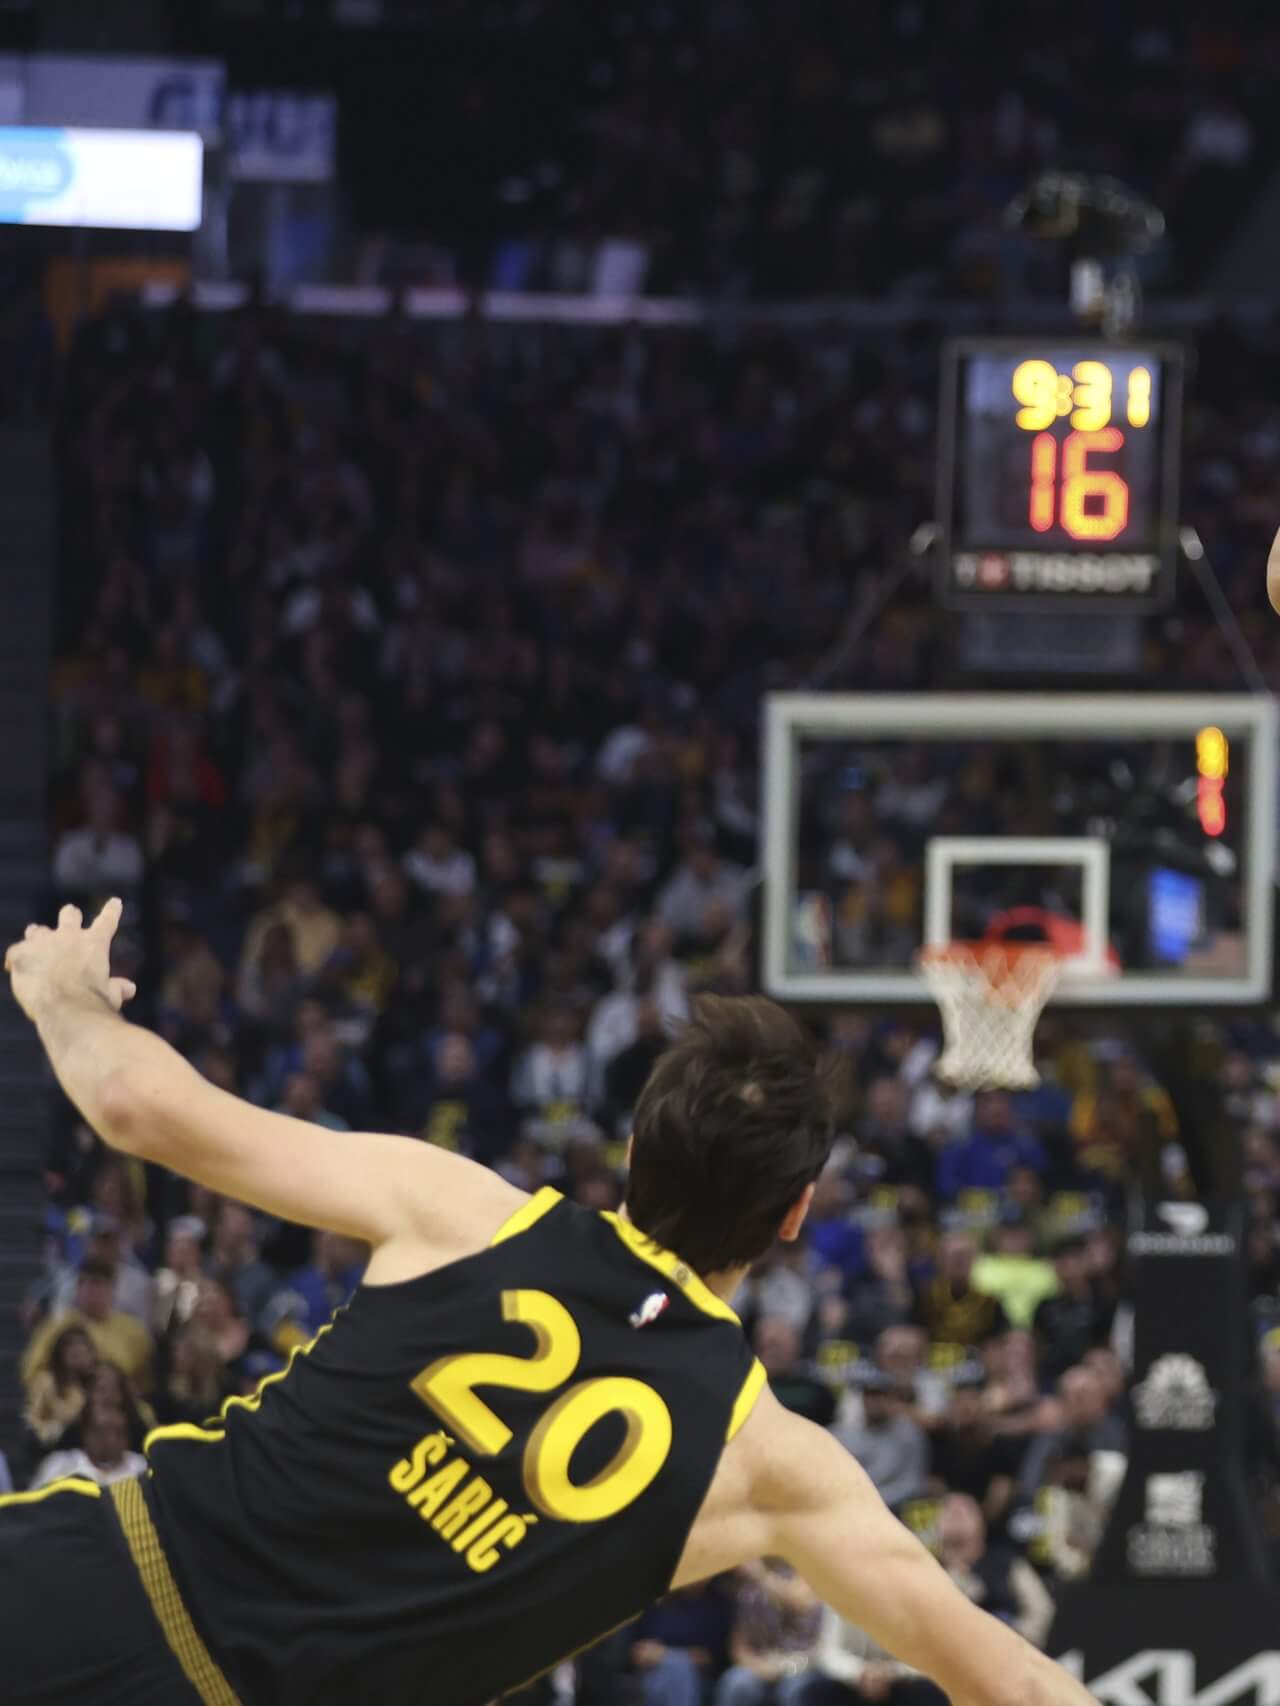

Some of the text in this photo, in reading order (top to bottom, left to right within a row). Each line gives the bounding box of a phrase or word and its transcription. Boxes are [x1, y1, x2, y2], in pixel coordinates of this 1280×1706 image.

[1012, 359, 1151, 431] 9:31
[1029, 427, 1129, 541] 16
[410, 1289, 672, 1523] 20
